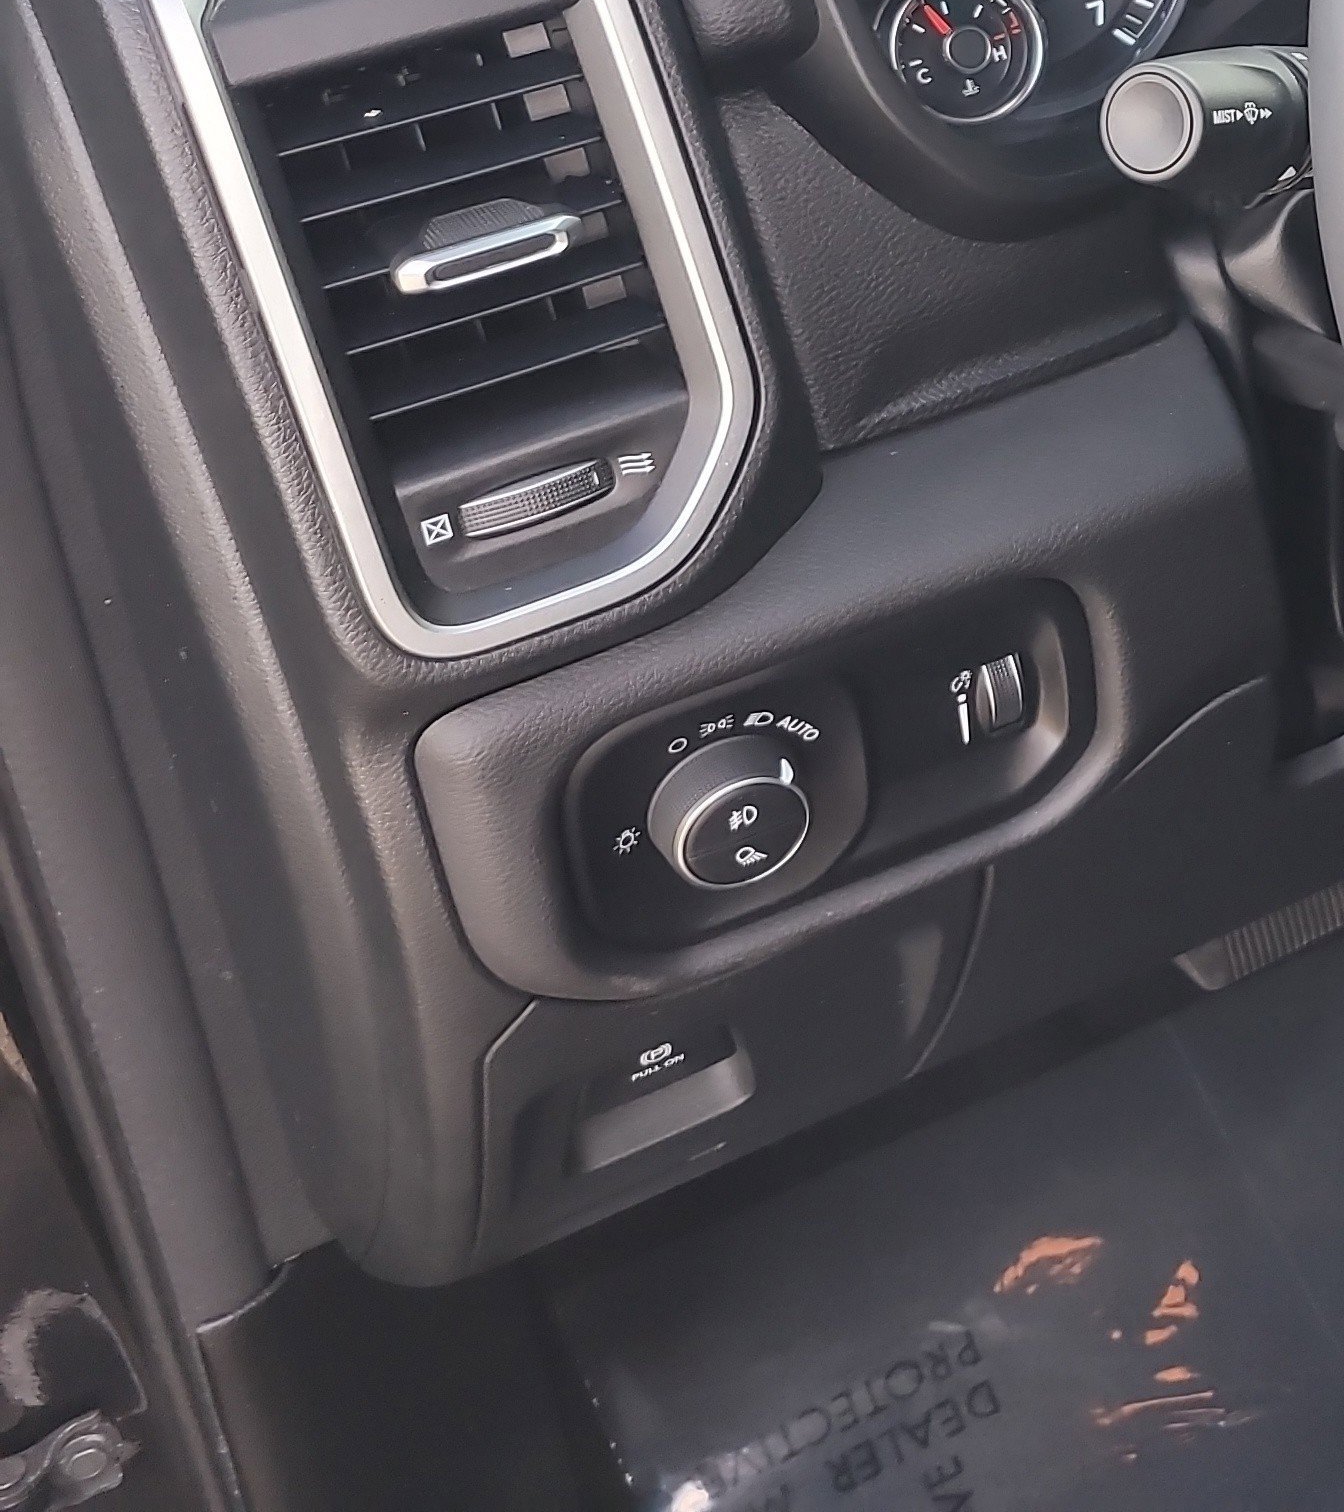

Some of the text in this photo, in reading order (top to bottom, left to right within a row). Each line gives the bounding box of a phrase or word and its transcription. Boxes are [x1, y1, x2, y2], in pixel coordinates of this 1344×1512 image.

[992, 45, 1008, 62] H
[916, 67, 933, 85] C
[1213, 108, 1236, 125] MIST
[776, 716, 820, 741] AUTO
[631, 1053, 685, 1082] PULL ON
[825, 1380, 1001, 1493] DEALER
